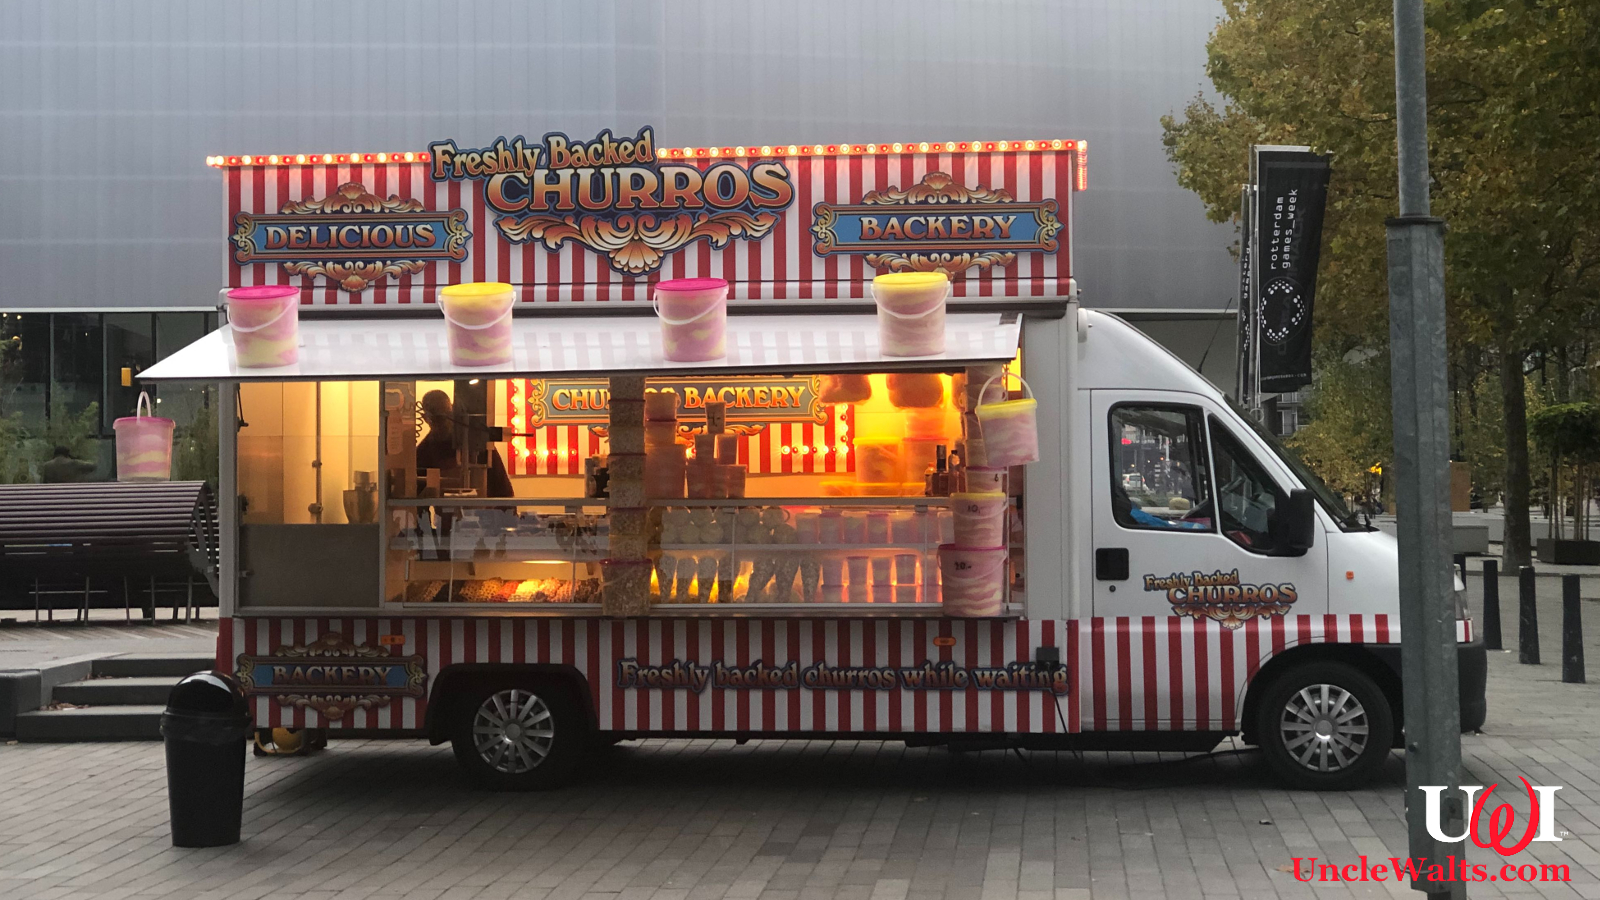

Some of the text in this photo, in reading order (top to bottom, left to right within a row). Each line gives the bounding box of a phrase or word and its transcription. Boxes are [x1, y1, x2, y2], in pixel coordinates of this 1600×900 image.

[433, 129, 653, 178] Freshly Backed
[487, 163, 794, 210] CHURROS
[264, 224, 437, 250] DELICIOUS
[860, 215, 1018, 240] BACKERY
[1270, 196, 1285, 270] rotterdam
[1282, 188, 1299, 269] games_week
[684, 385, 806, 408] BACKERY
[1144, 569, 1239, 590] Freshly Backed
[1168, 584, 1297, 604] CHURROS
[273, 665, 392, 687] BACKERY
[619, 660, 1068, 694] Freshly backed churros while waiting
